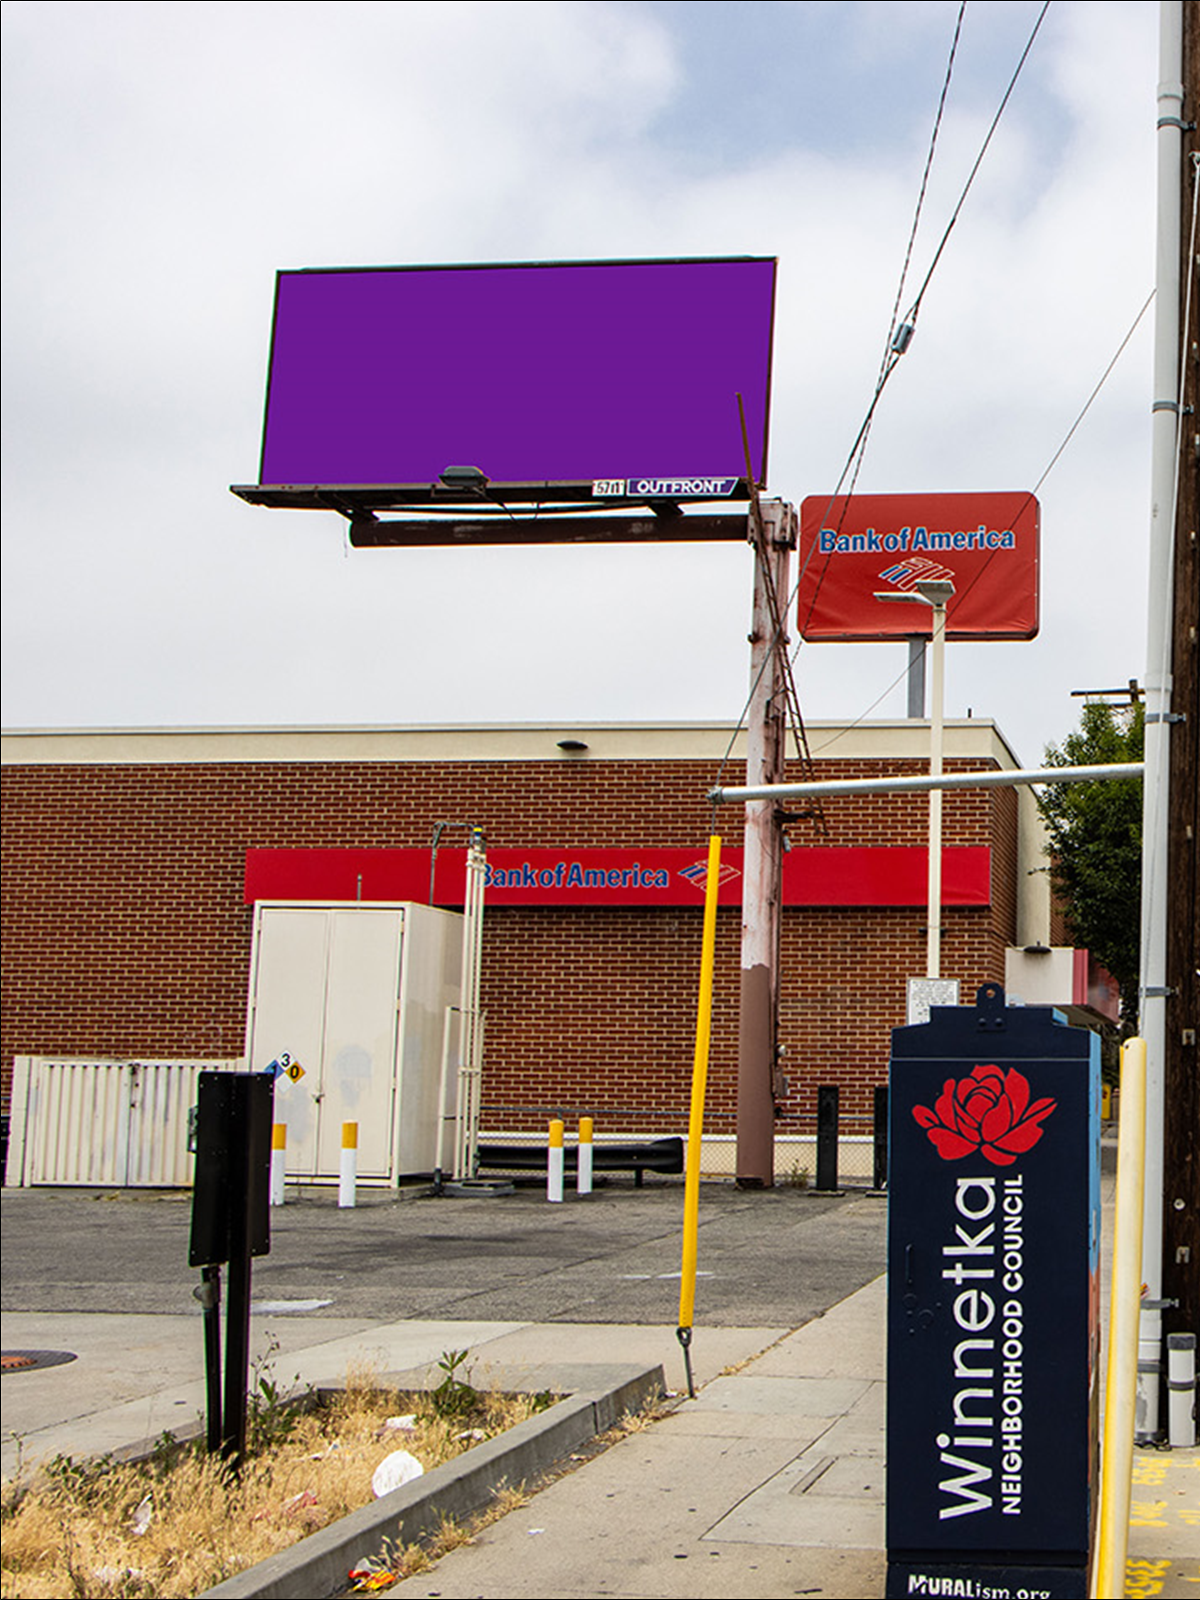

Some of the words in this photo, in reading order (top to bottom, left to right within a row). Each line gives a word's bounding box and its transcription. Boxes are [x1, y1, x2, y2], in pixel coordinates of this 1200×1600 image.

[637, 480, 726, 494] OUTFRONT
[819, 528, 882, 553] Bank
[884, 527, 911, 551] of
[912, 525, 1016, 550] America
[539, 862, 566, 888] of
[567, 862, 669, 888] America
[281, 1053, 290, 1067] 3
[290, 1065, 299, 1079] 0
[1002, 1174, 1024, 1293] COUNCIL
[936, 1177, 996, 1520] Winnetka
[1001, 1299, 1024, 1515] NEIGHBORHOOD
